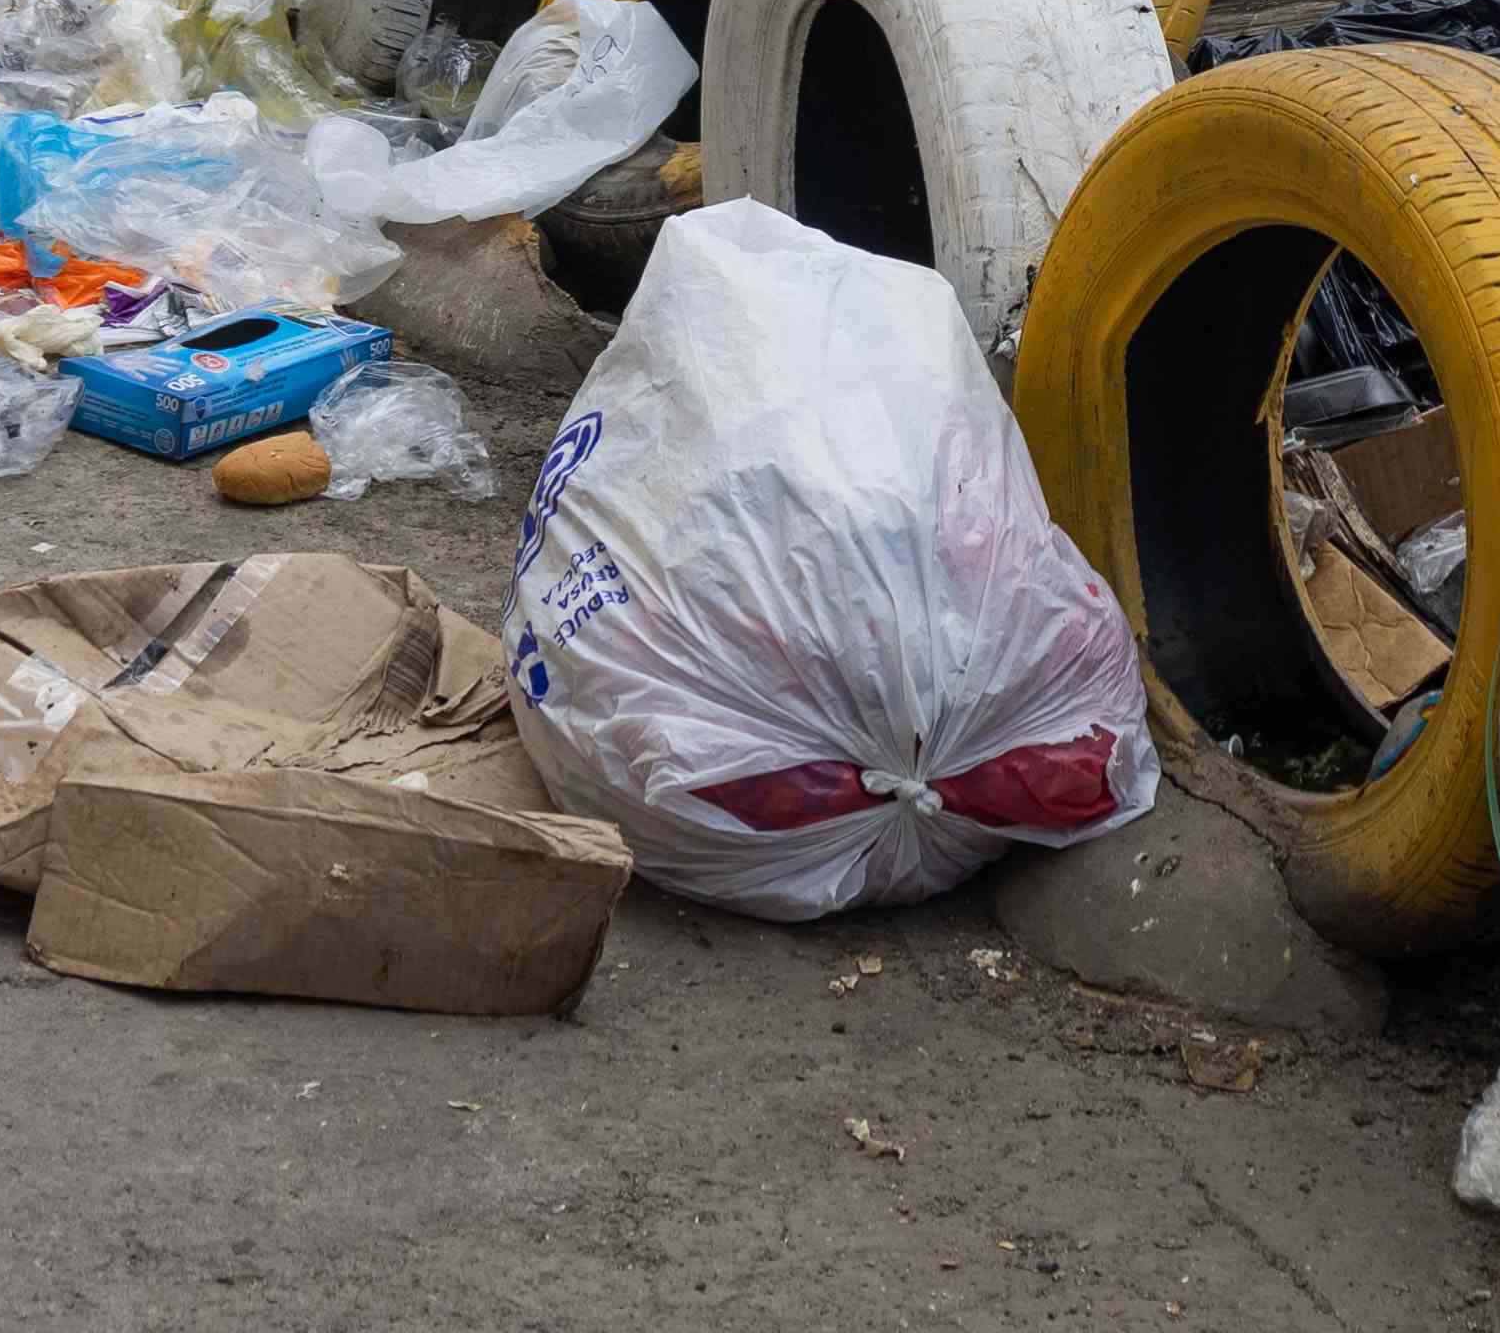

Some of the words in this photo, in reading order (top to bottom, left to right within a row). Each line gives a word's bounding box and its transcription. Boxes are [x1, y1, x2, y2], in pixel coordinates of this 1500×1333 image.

[369, 338, 391, 356] 500
[168, 371, 206, 391] 500
[156, 393, 179, 413] 500
[554, 584, 630, 649] REDUCE
